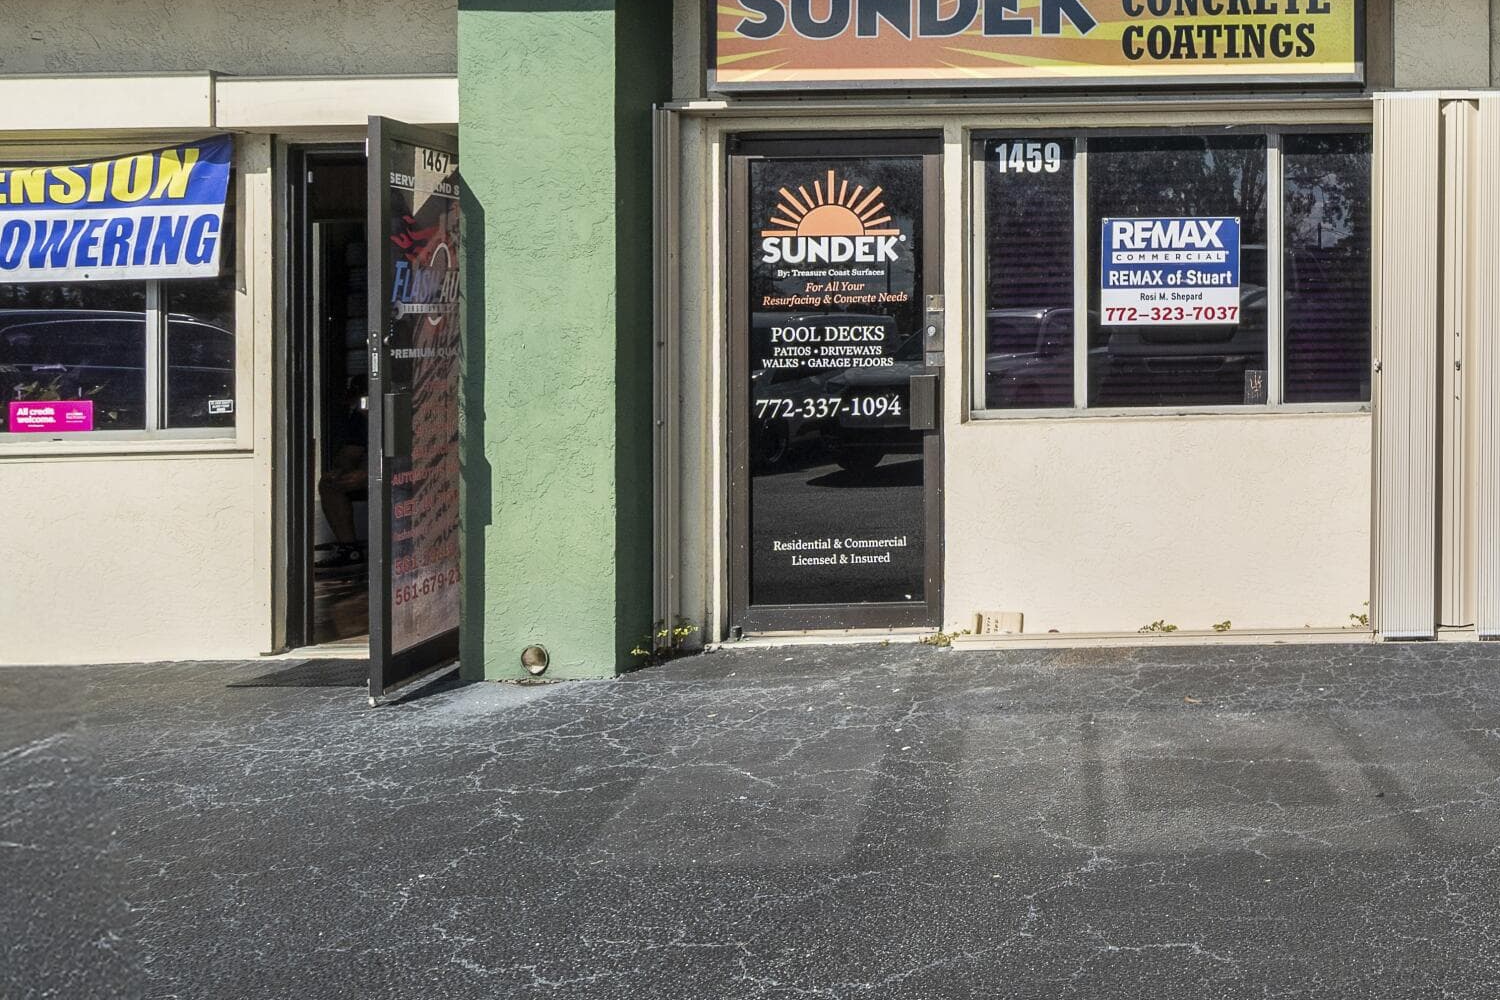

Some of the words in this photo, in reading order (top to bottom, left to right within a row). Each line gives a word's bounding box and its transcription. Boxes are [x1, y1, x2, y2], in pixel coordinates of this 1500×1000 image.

[1121, 23, 1316, 61] COATINGS
[423, 149, 449, 173] 1467
[995, 142, 1061, 173] 1459
[0, 147, 200, 205] NSION
[761, 236, 899, 264] SUNDEK
[1116, 253, 1221, 261] COMMERCIAL
[777, 269, 791, 277] By:
[791, 269, 827, 277] Treasure
[851, 268, 885, 276] Surfaces
[1109, 270, 1163, 285] REMAX
[1167, 271, 1182, 285] of
[1186, 270, 1232, 284] Stuart
[805, 282, 825, 293] For
[826, 282, 840, 292] All
[841, 281, 865, 291] Your
[762, 295, 821, 306] Resurfacing
[823, 295, 832, 304] &
[833, 293, 876, 304] Concrete
[878, 291, 907, 302] Needs
[1140, 292, 1157, 301] Rosi
[1171, 292, 1203, 302] Shepard
[771, 326, 821, 342] POOL
[824, 326, 885, 342] DECKS
[774, 346, 811, 356] PATIOS
[820, 345, 882, 356] DRIVEWAYS
[762, 358, 799, 368] WALKS
[807, 358, 851, 368] GARAGE
[852, 357, 894, 367] FLOORS
[16, 407, 29, 416] All
[755, 394, 901, 418] 772-337-1094
[773, 538, 831, 551] Residential
[833, 538, 842, 549] &
[844, 536, 907, 549] Commercial
[791, 553, 837, 566] Licensed
[839, 554, 848, 564] &
[850, 552, 890, 564] Insured
